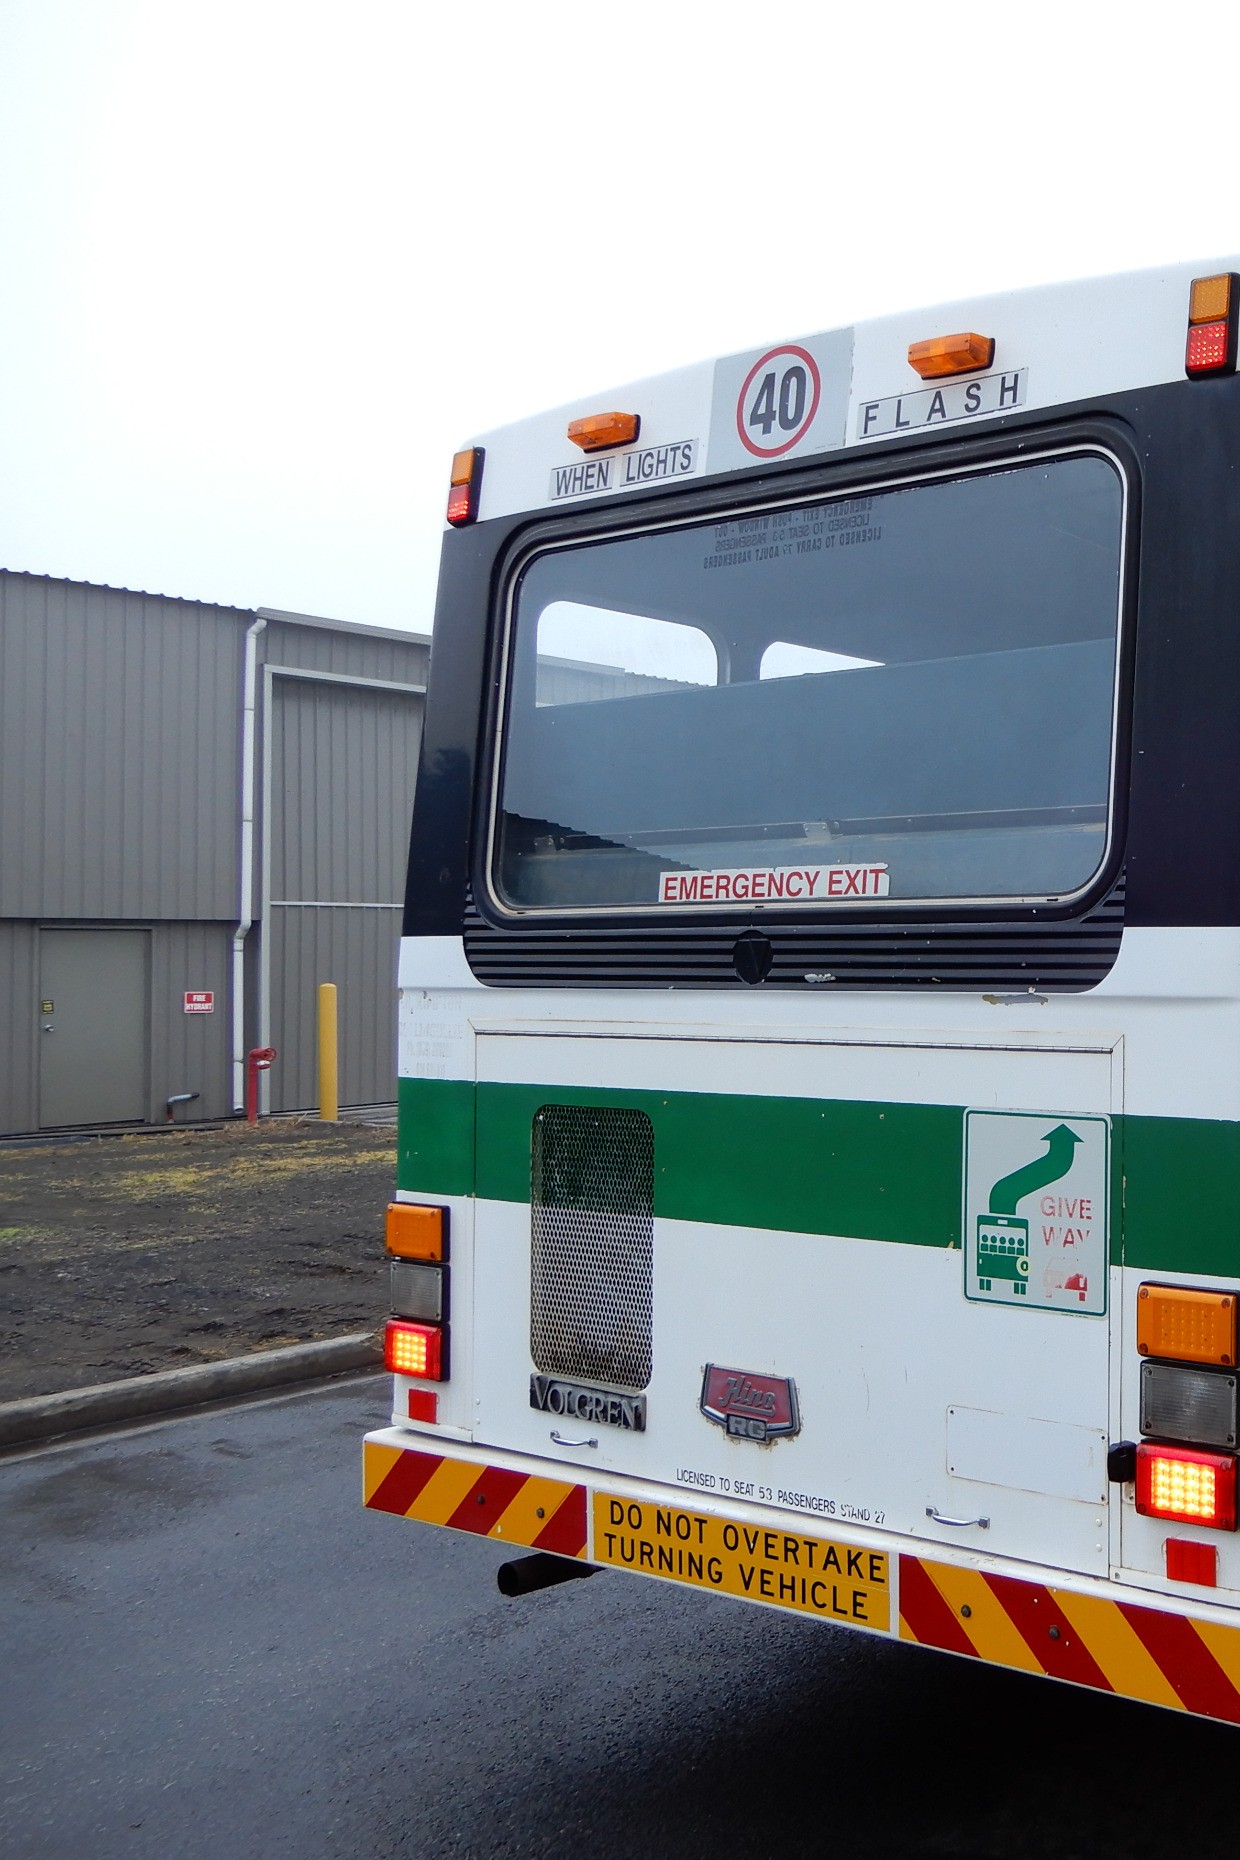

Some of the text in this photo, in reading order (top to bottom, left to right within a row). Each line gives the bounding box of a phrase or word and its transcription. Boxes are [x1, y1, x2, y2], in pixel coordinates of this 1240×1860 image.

[749, 365, 807, 435] 40
[862, 376, 1020, 435] FLASH
[555, 445, 693, 496] WHEN LIGHTS
[664, 869, 887, 901] EMERGENCY EXIT
[1040, 1196, 1092, 1220] GIVE
[532, 1374, 640, 1430] VOLGREN
[718, 1375, 777, 1411] Hino
[676, 1468, 716, 1489] LICENSED
[719, 1478, 731, 1492] TO
[734, 1480, 755, 1497] SEAT
[758, 1487, 773, 1501] 53
[777, 1490, 836, 1515] PASSENGERS
[840, 1504, 871, 1522] STAND
[609, 1500, 886, 1584] DO NOT OVERTAKE
[603, 1533, 869, 1621] TURNING VEHICLE
